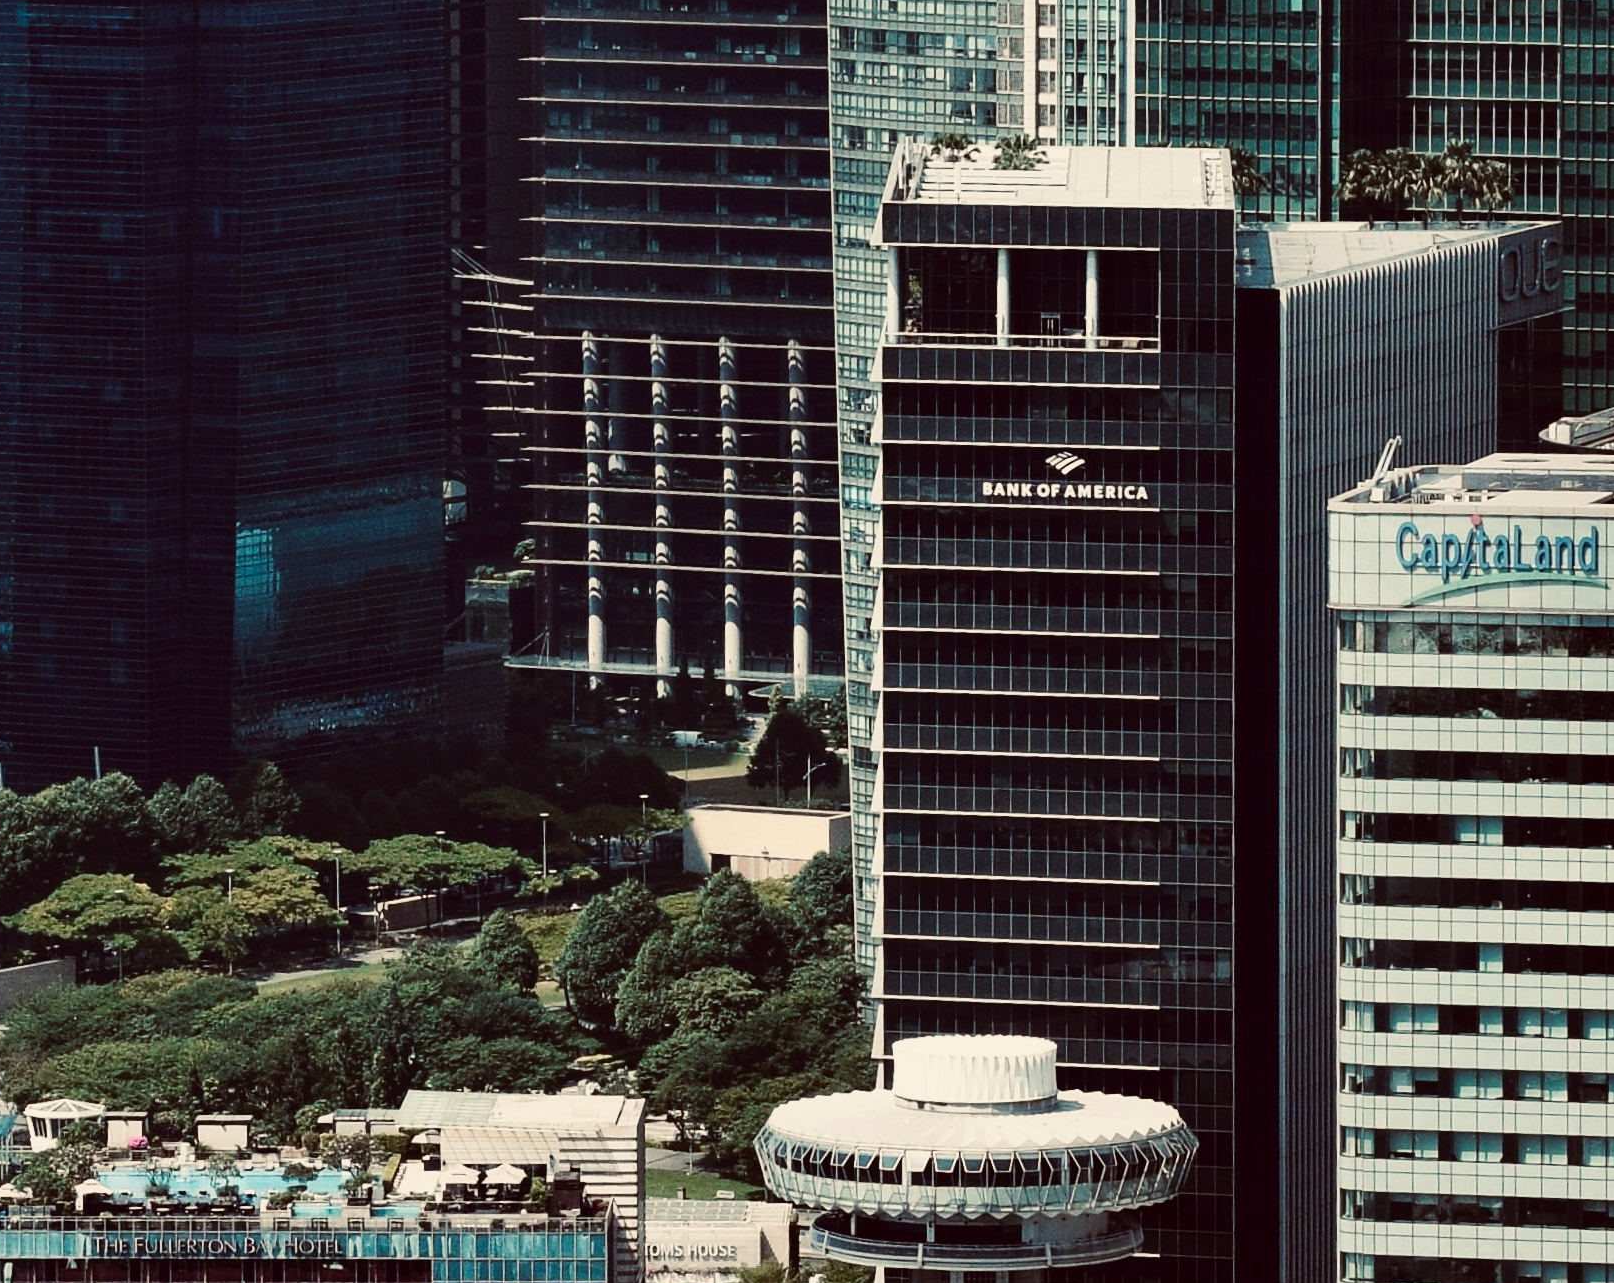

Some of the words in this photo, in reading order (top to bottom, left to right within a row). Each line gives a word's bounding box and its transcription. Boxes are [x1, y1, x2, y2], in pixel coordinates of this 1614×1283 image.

[982, 481, 1033, 498] BANK
[1036, 483, 1061, 498] OF
[1063, 484, 1149, 500] AMERICA
[1395, 514, 1600, 585] CapitaLand
[92, 1236, 130, 1254] THE
[134, 1236, 238, 1255] FULLERTON
[284, 1236, 344, 1255] HOTEL
[688, 1243, 737, 1258] HOUSE
